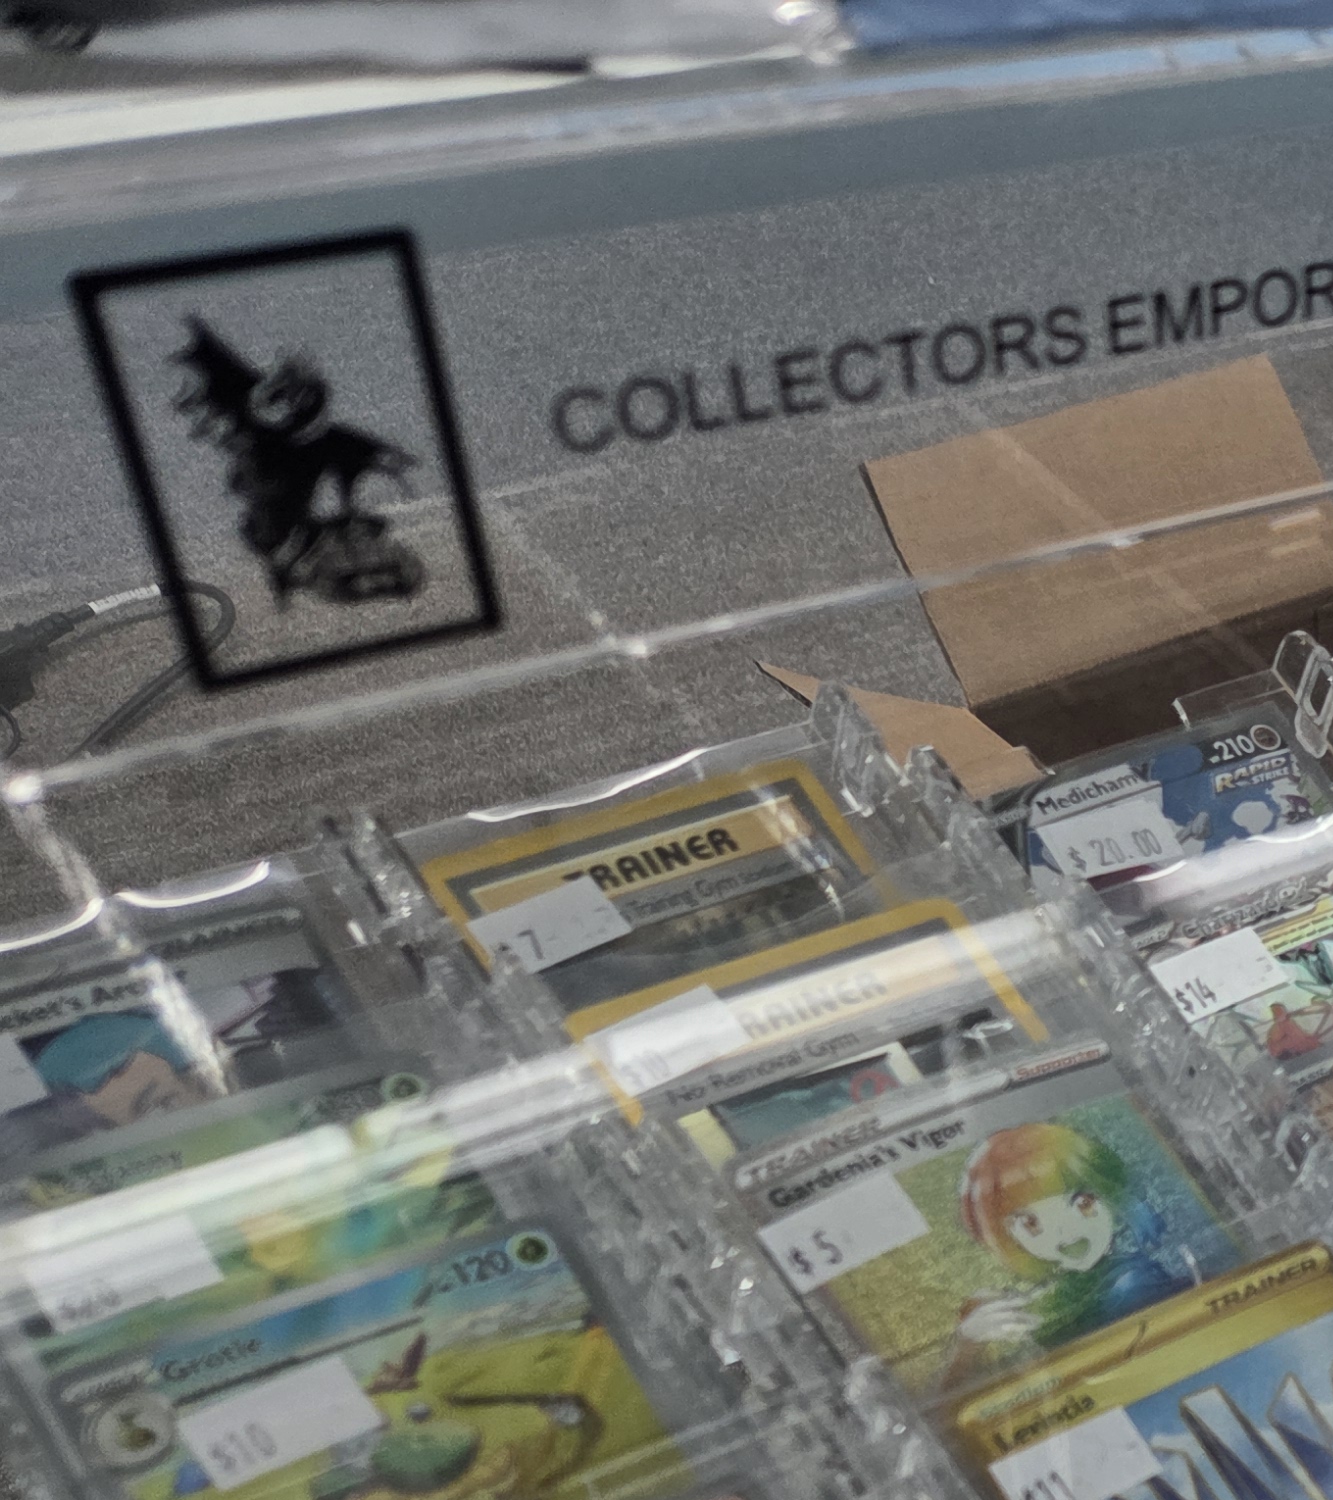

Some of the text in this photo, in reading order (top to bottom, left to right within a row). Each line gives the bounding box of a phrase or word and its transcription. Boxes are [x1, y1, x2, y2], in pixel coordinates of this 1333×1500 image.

[549, 305, 1090, 455] COLLECTORS
[1215, 735, 1253, 763] 210
[1035, 770, 1138, 817] Medicham
[1213, 754, 1289, 795] RAPID
[1098, 826, 1164, 868] 20.00
[1176, 977, 1218, 1015] $14
[803, 1031, 860, 1062] Gym
[768, 1116, 968, 1208] Gardenia's Vigor
